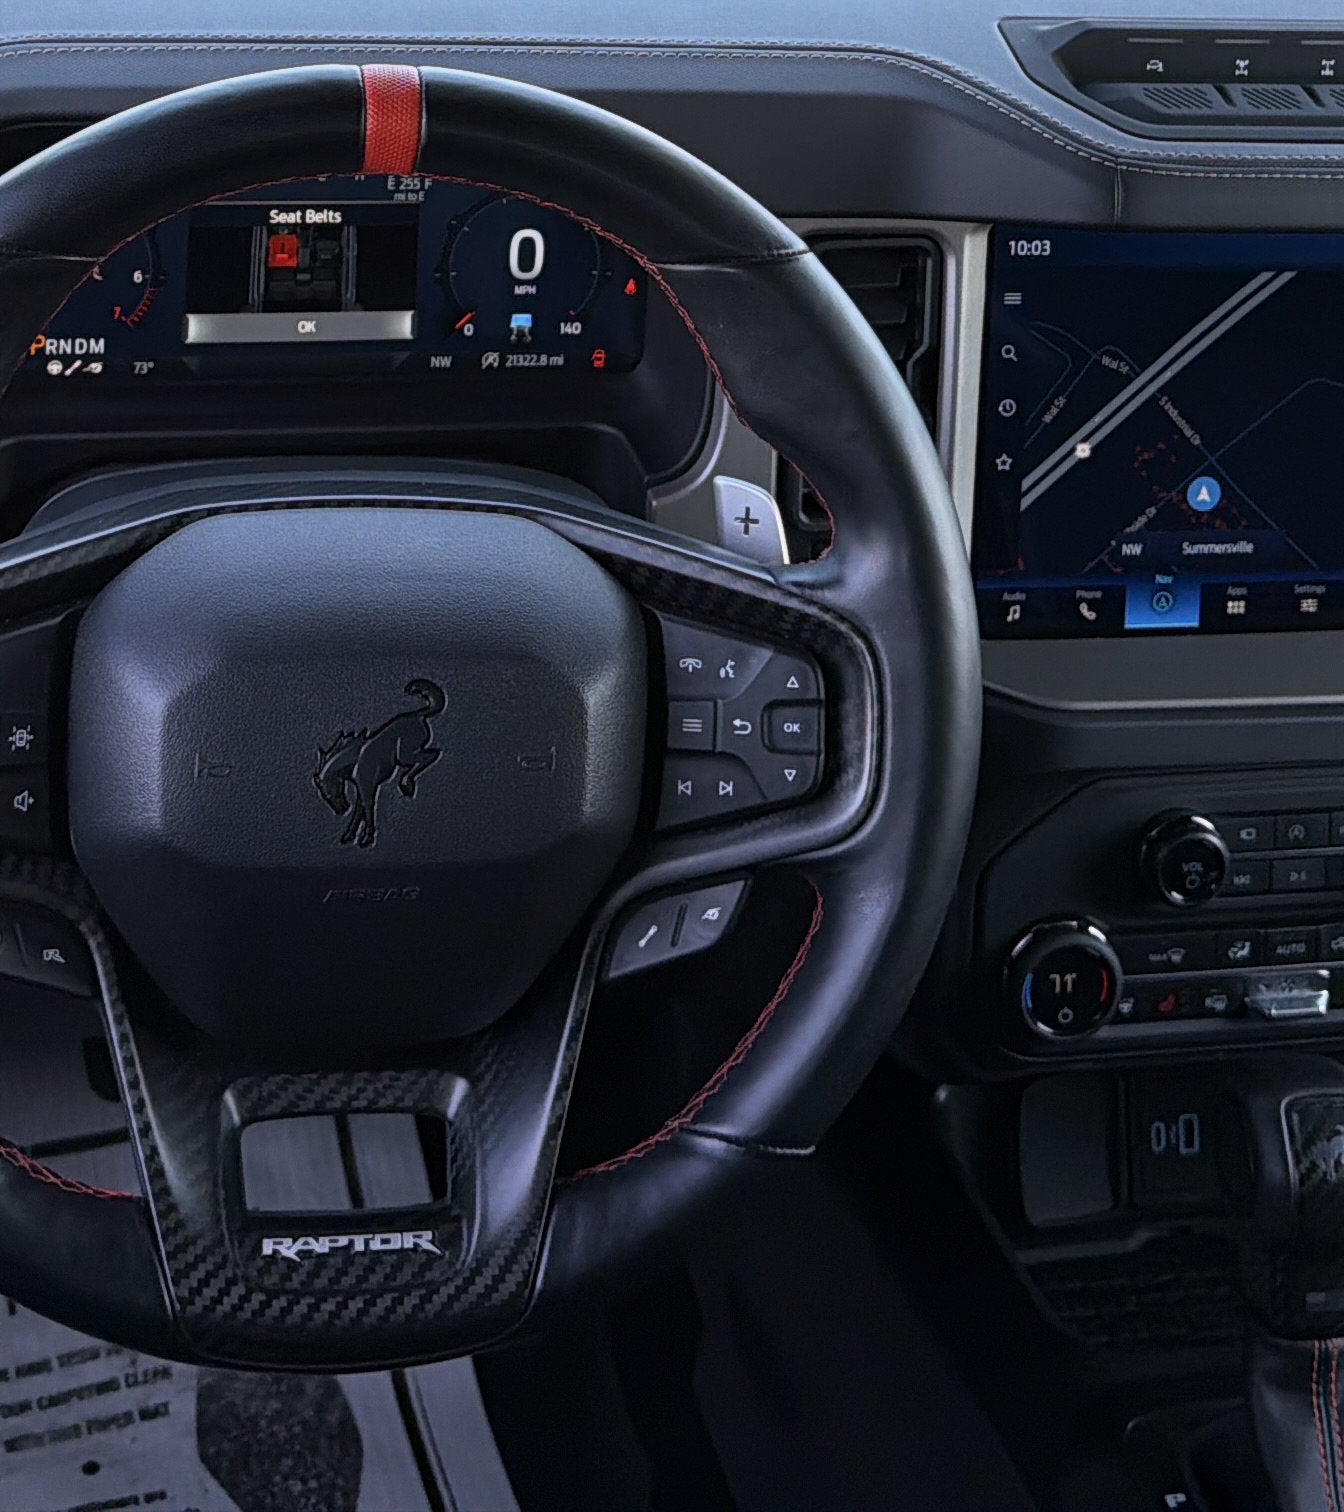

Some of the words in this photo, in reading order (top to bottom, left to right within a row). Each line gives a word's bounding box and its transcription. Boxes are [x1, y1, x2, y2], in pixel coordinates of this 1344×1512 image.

[399, 178, 421, 190] 255
[424, 178, 432, 190] F
[269, 209, 303, 224] Seat
[306, 209, 342, 224] Belts
[509, 228, 545, 280] 0
[1008, 239, 1051, 256] 10:03
[133, 270, 143, 283] 6
[514, 285, 536, 295] MPH
[297, 320, 317, 333] OK
[463, 324, 474, 336] 0
[560, 322, 582, 335] 140
[430, 355, 452, 368] NW
[505, 354, 548, 367] 21322.8
[549, 353, 565, 366] mi
[1121, 542, 1143, 556] NW
[1182, 541, 1254, 555] Summersville
[783, 722, 801, 734] OK
[261, 1230, 445, 1263] RAPTOR
